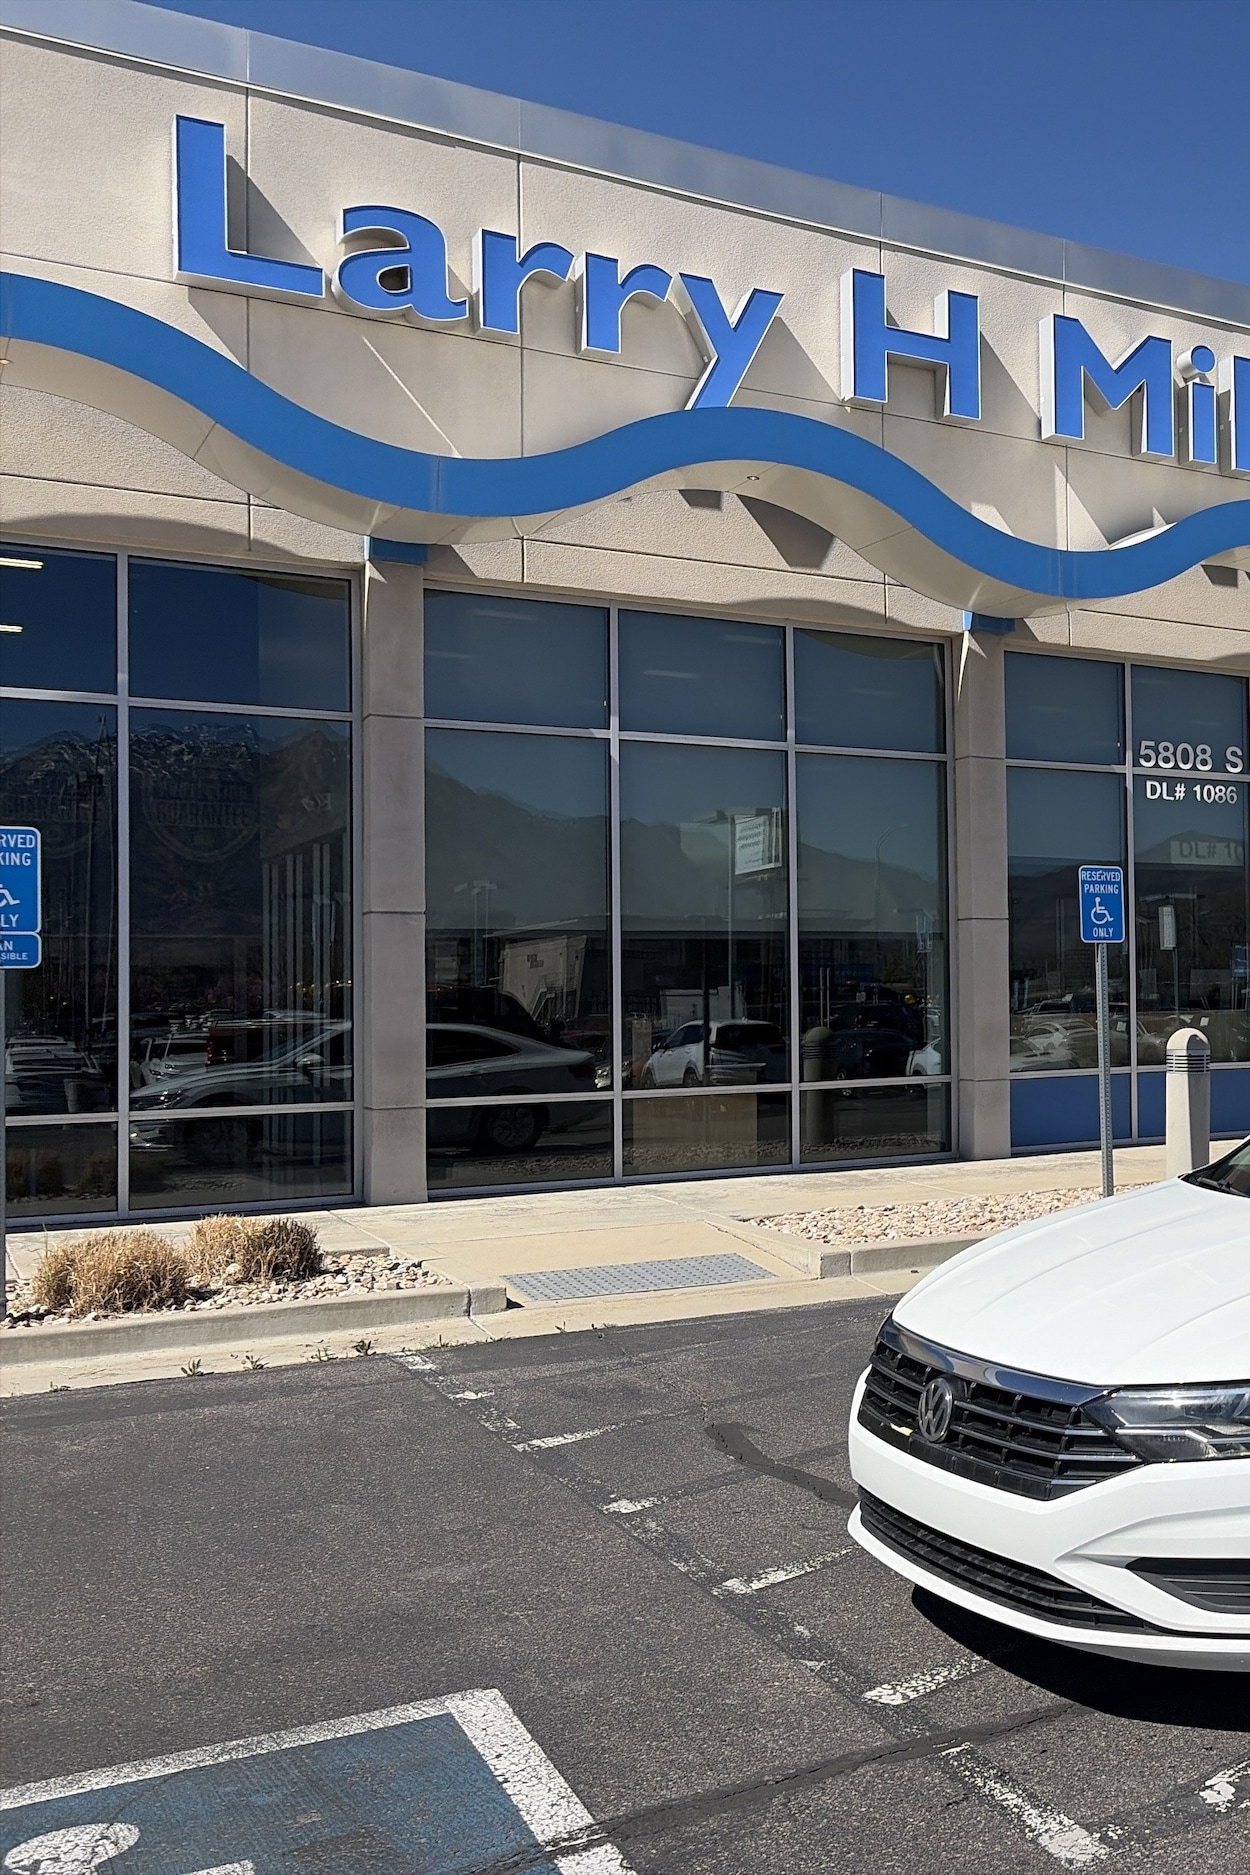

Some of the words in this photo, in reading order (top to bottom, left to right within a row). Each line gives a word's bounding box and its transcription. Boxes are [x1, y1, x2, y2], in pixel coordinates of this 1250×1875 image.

[171, 113, 785, 411] Larry
[840, 267, 982, 422] H
[1138, 740, 1213, 771] 5808
[1225, 746, 1244, 773] S
[1145, 780, 1186, 801] DL#
[1193, 784, 1238, 804] 1086
[1081, 871, 1121, 882] RESERVED
[1084, 884, 1119, 895] PARKING
[1092, 927, 1114, 938] ONLY
